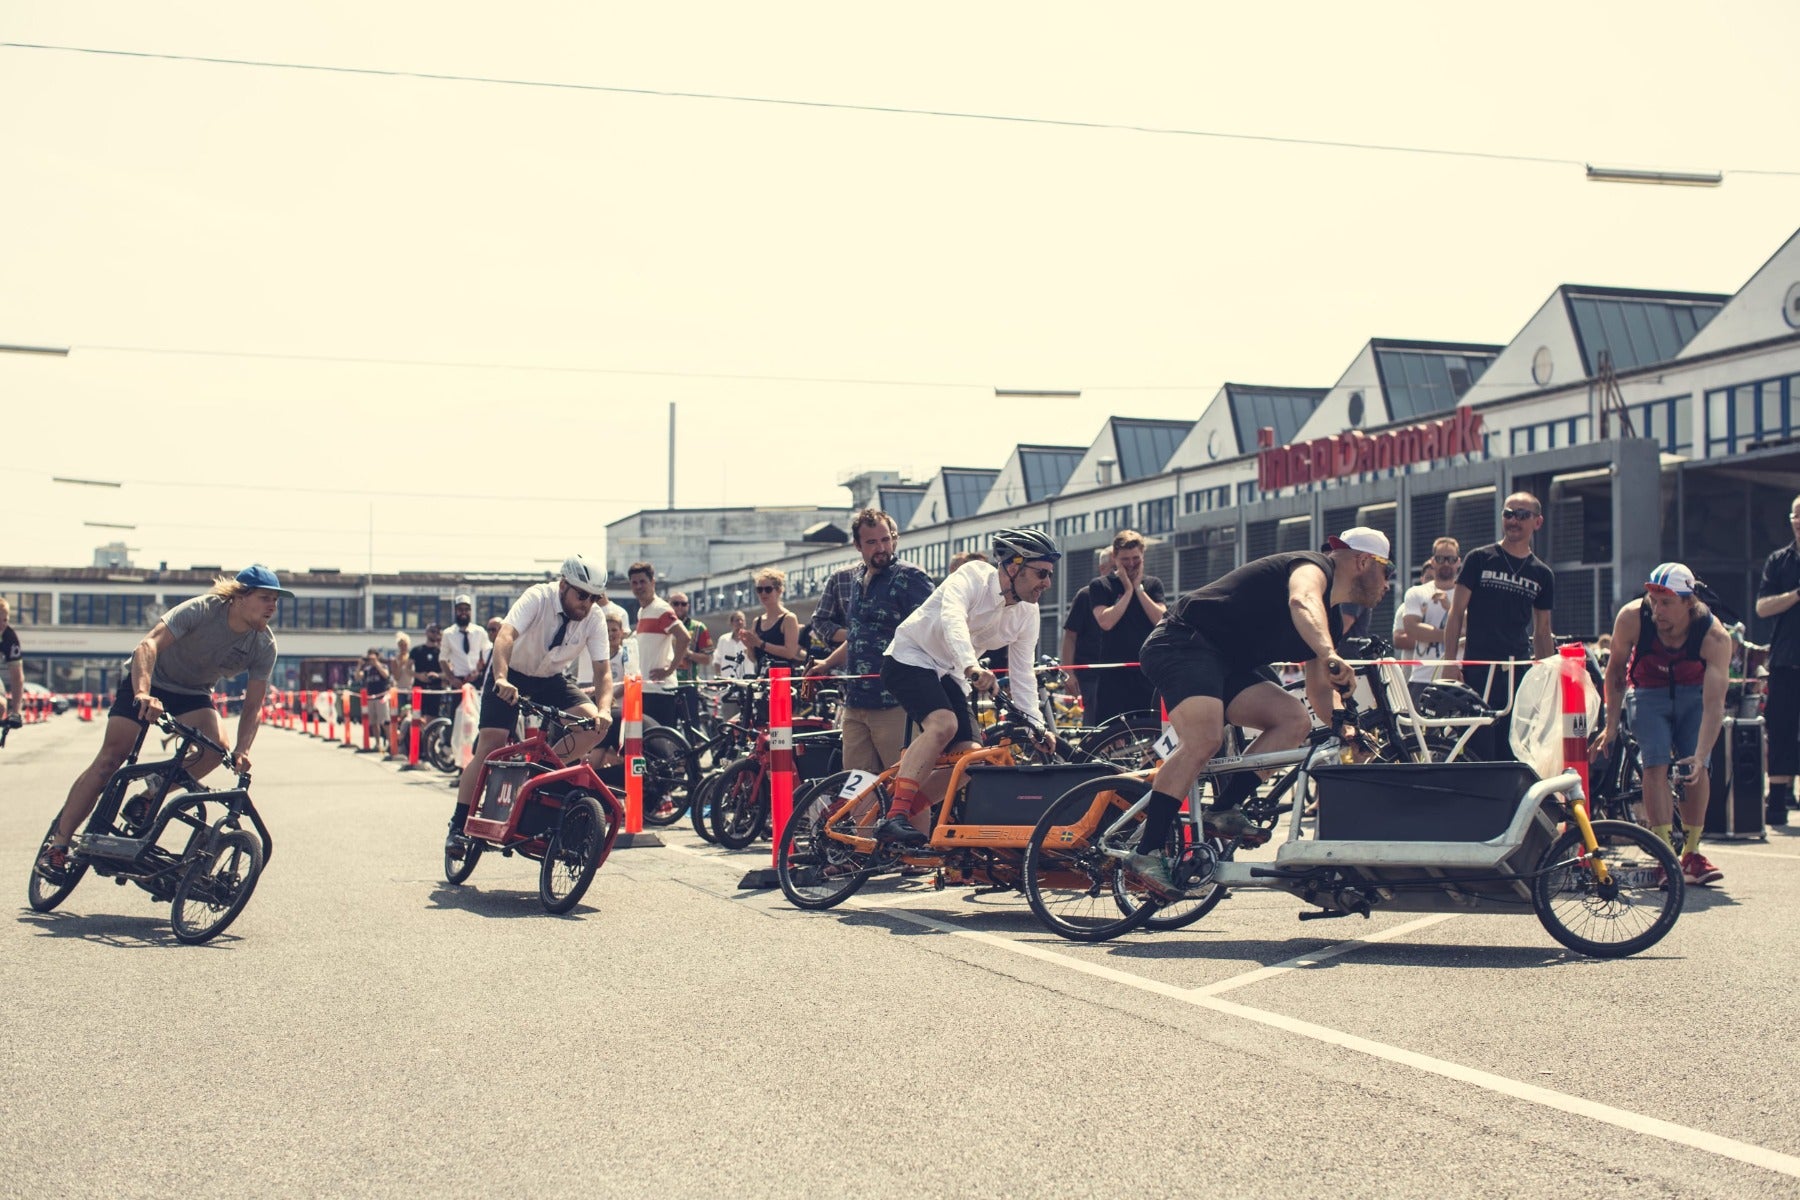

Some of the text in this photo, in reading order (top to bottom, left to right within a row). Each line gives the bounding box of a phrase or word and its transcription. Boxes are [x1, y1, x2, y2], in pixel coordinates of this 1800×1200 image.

[1481, 570, 1541, 592] BULLITT
[1162, 735, 1177, 755] 1
[845, 774, 863, 791] 2
